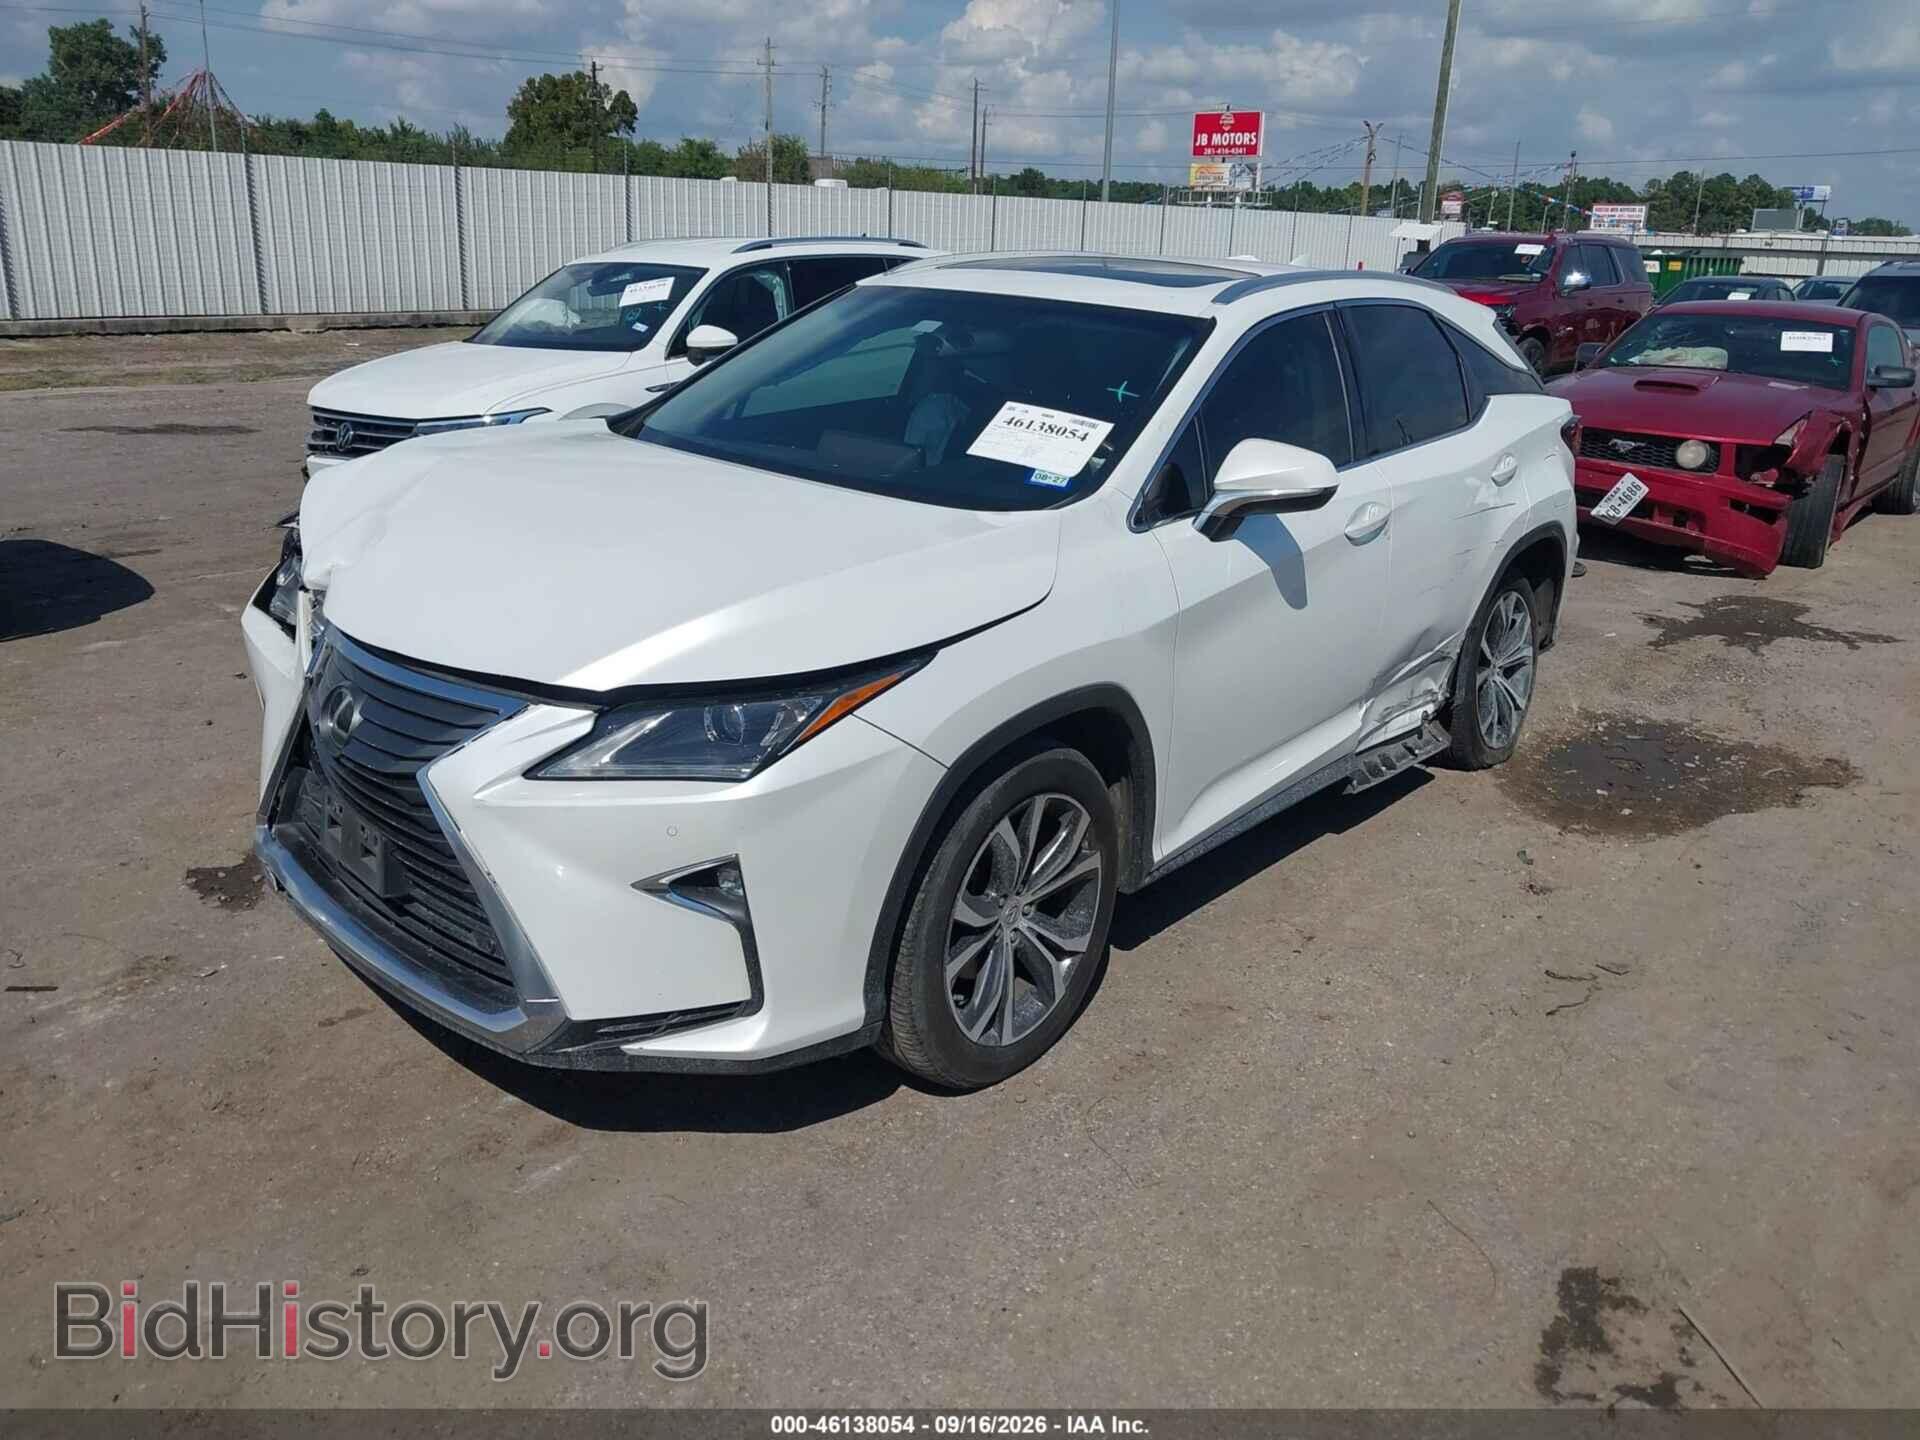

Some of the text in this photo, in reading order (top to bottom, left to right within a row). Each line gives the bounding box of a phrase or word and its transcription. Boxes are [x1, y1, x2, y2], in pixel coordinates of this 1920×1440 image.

[1195, 132, 1257, 146] JB MOTORS
[1003, 416, 1090, 442] 46138054
